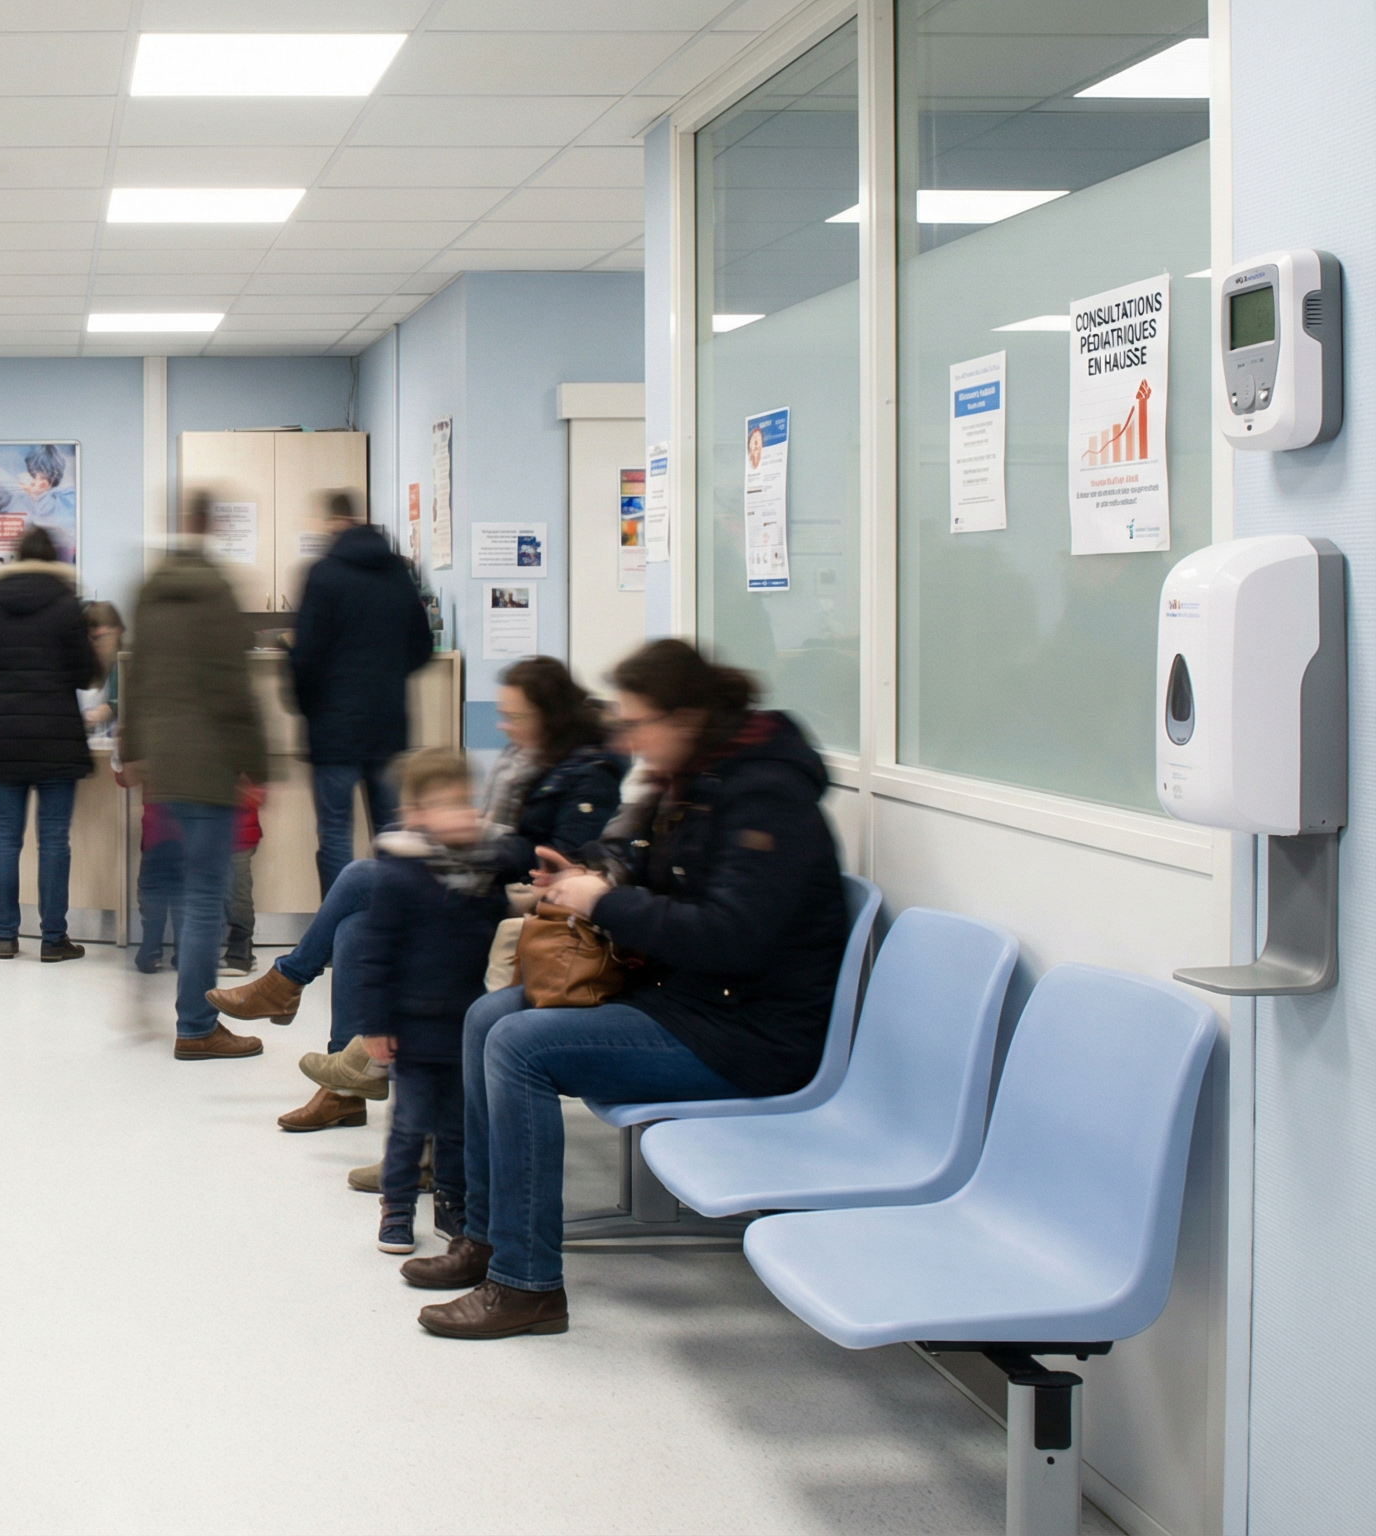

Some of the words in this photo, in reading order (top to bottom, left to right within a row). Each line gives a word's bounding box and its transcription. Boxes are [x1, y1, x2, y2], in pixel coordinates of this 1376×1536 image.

[1075, 291, 1163, 332] CONSULTATIONS
[1088, 355, 1102, 376] EN
[1104, 345, 1147, 373] HAUSSE
